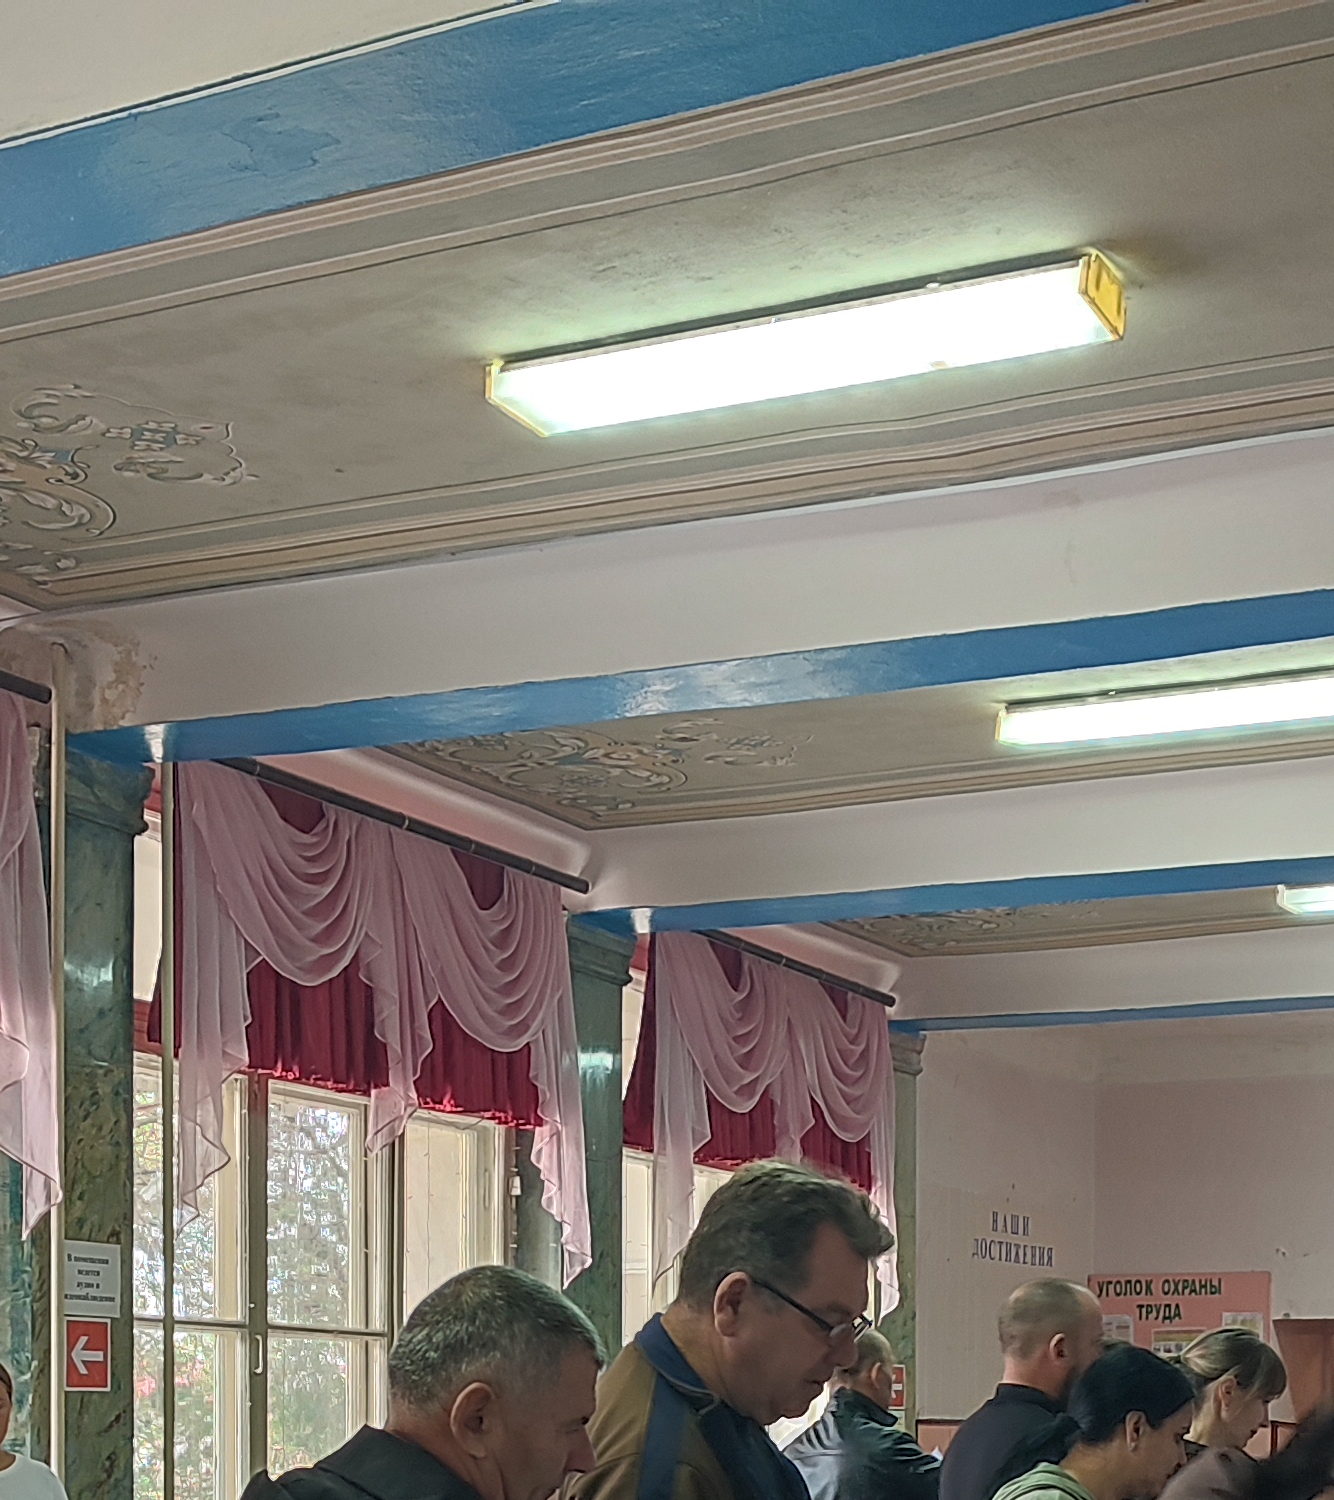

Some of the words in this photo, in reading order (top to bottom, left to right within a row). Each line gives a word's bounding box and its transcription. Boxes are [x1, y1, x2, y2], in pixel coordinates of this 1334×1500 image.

[992, 1211, 1031, 1237] НАШИ
[972, 1237, 1054, 1268] ДОСТИЖЕНИЯ
[1097, 1279, 1154, 1298] УГОЛОК
[1162, 1277, 1222, 1296] ОХРАНЫ
[1136, 1303, 1182, 1324] ТРУДА
